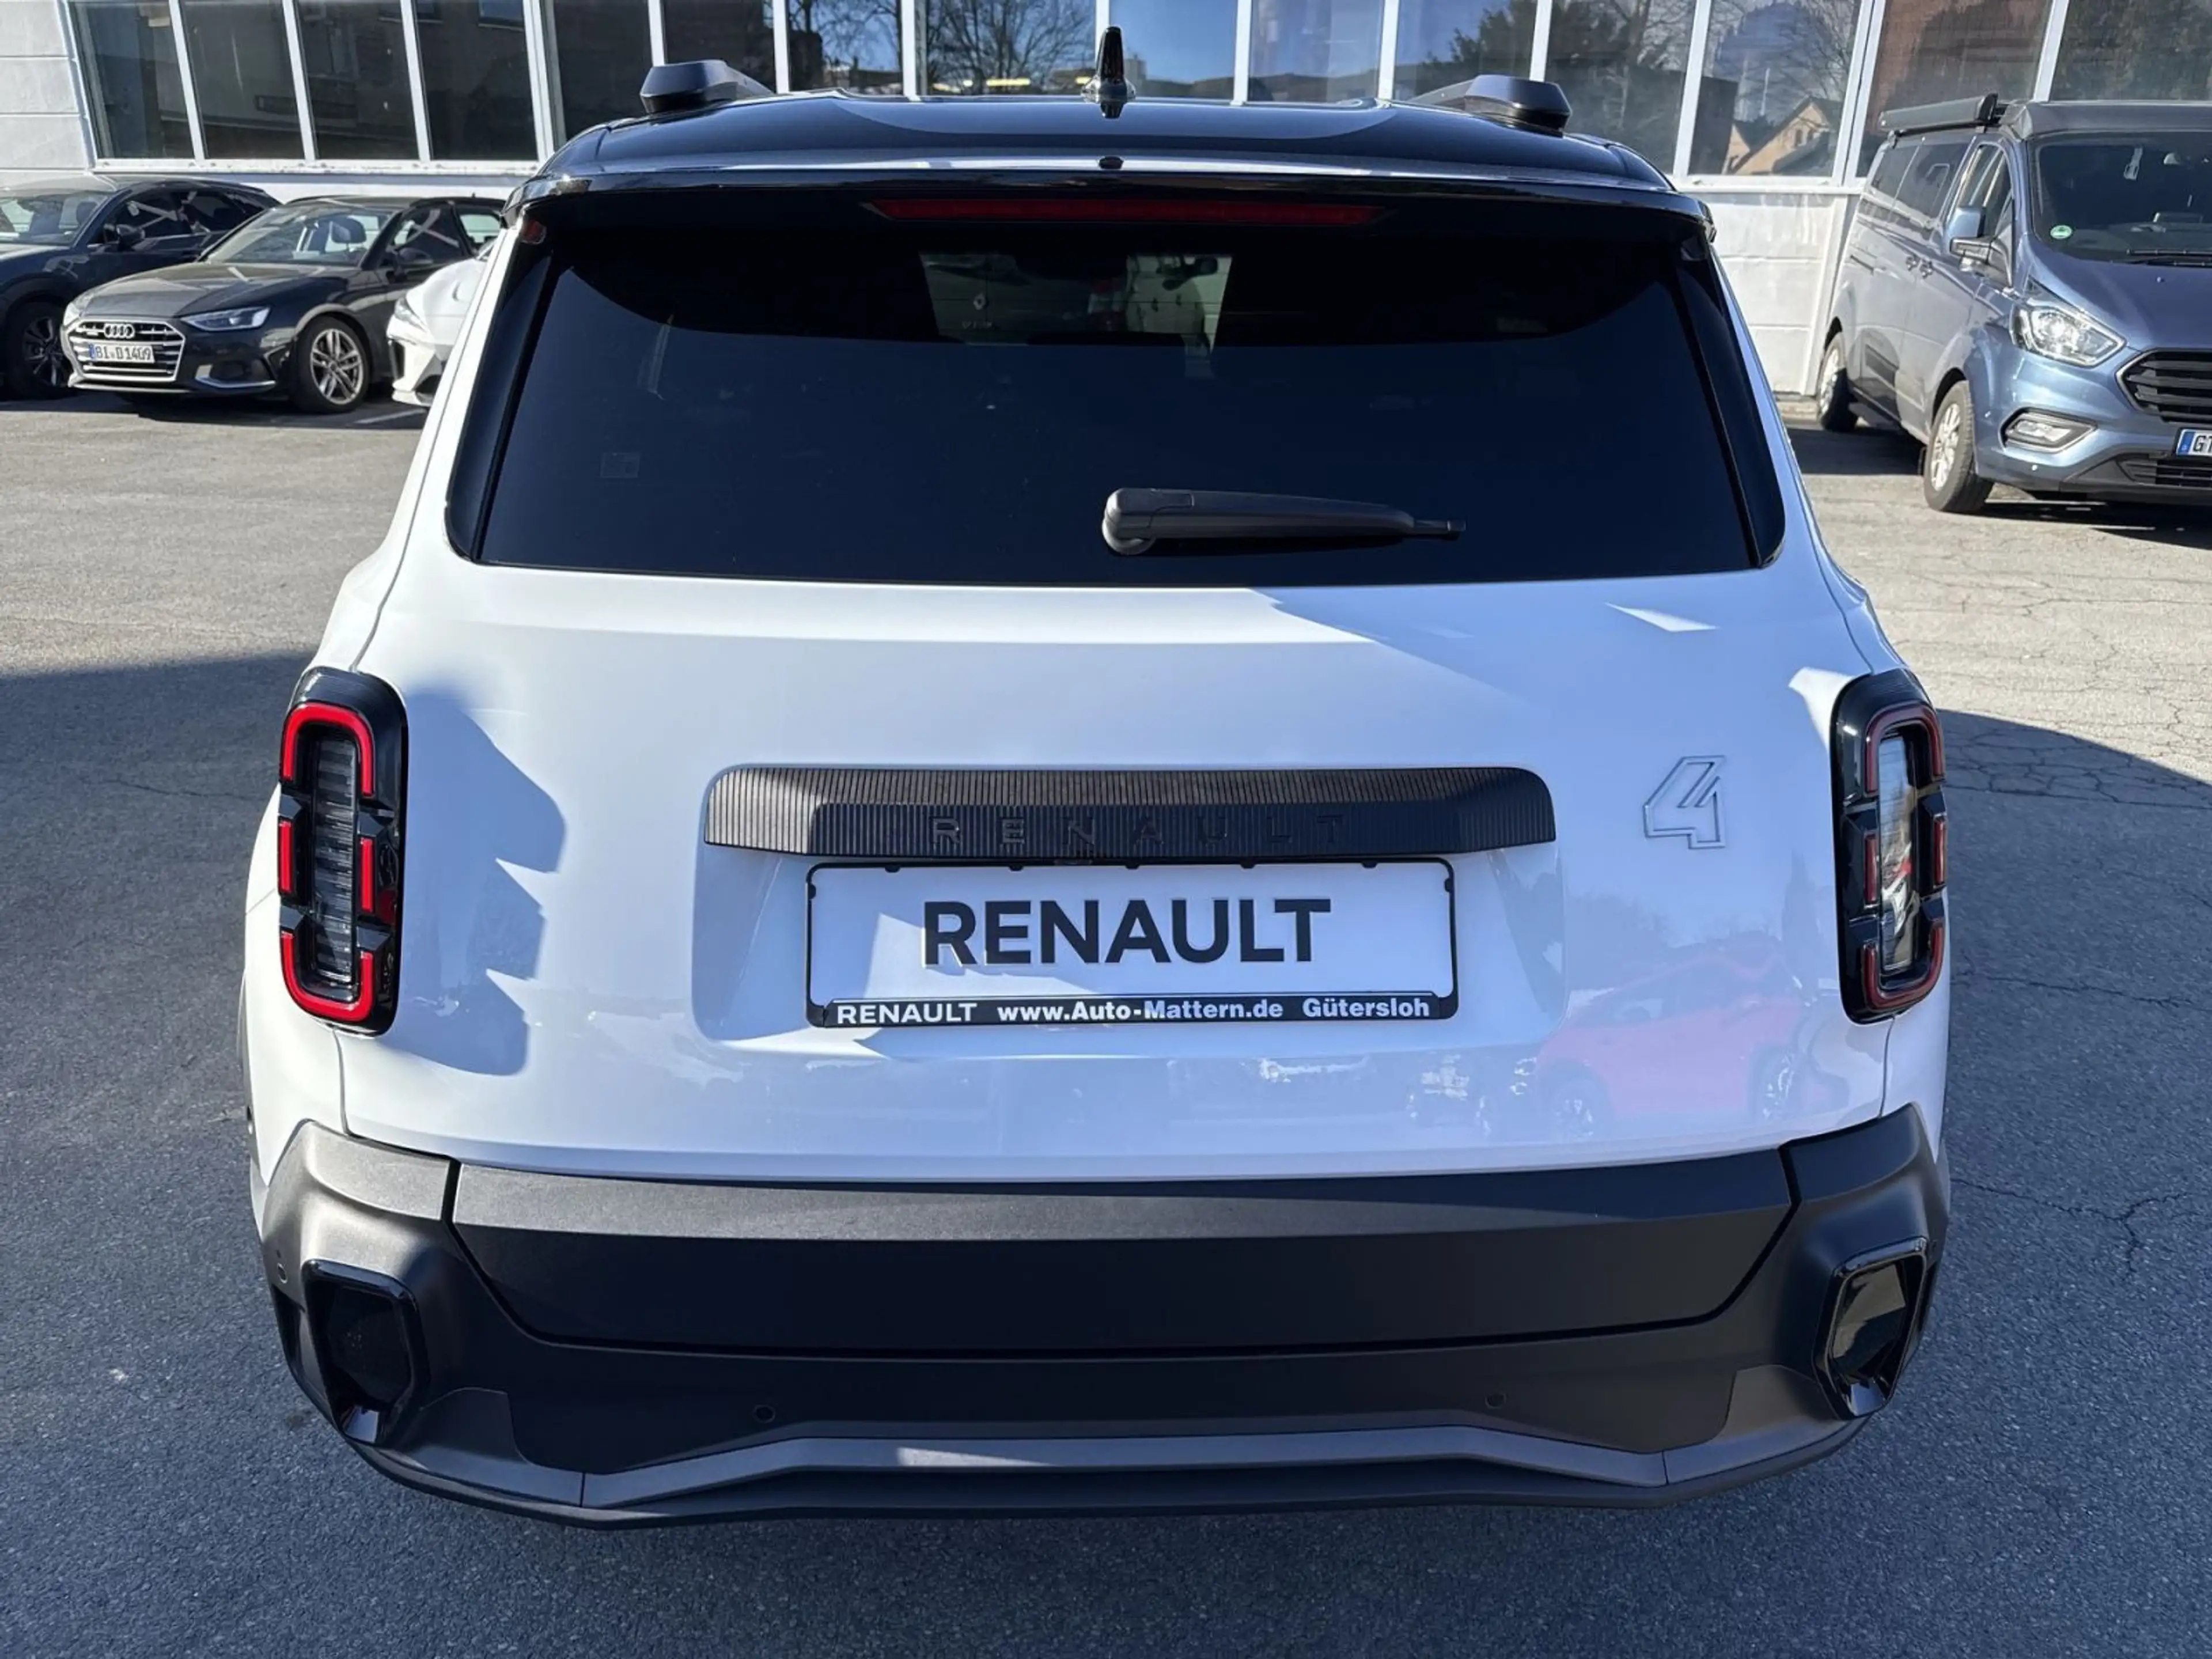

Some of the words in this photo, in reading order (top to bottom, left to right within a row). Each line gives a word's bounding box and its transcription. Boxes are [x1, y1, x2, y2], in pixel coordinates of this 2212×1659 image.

[1642, 755, 1726, 850] 4
[931, 814, 1344, 845] RENAULT
[923, 899, 1331, 966] RENAULT
[836, 1002, 978, 1024] RENAULT
[997, 998, 1284, 1022] www.Auto-Mattern.de
[1302, 997, 1430, 1018] Gütersloh
